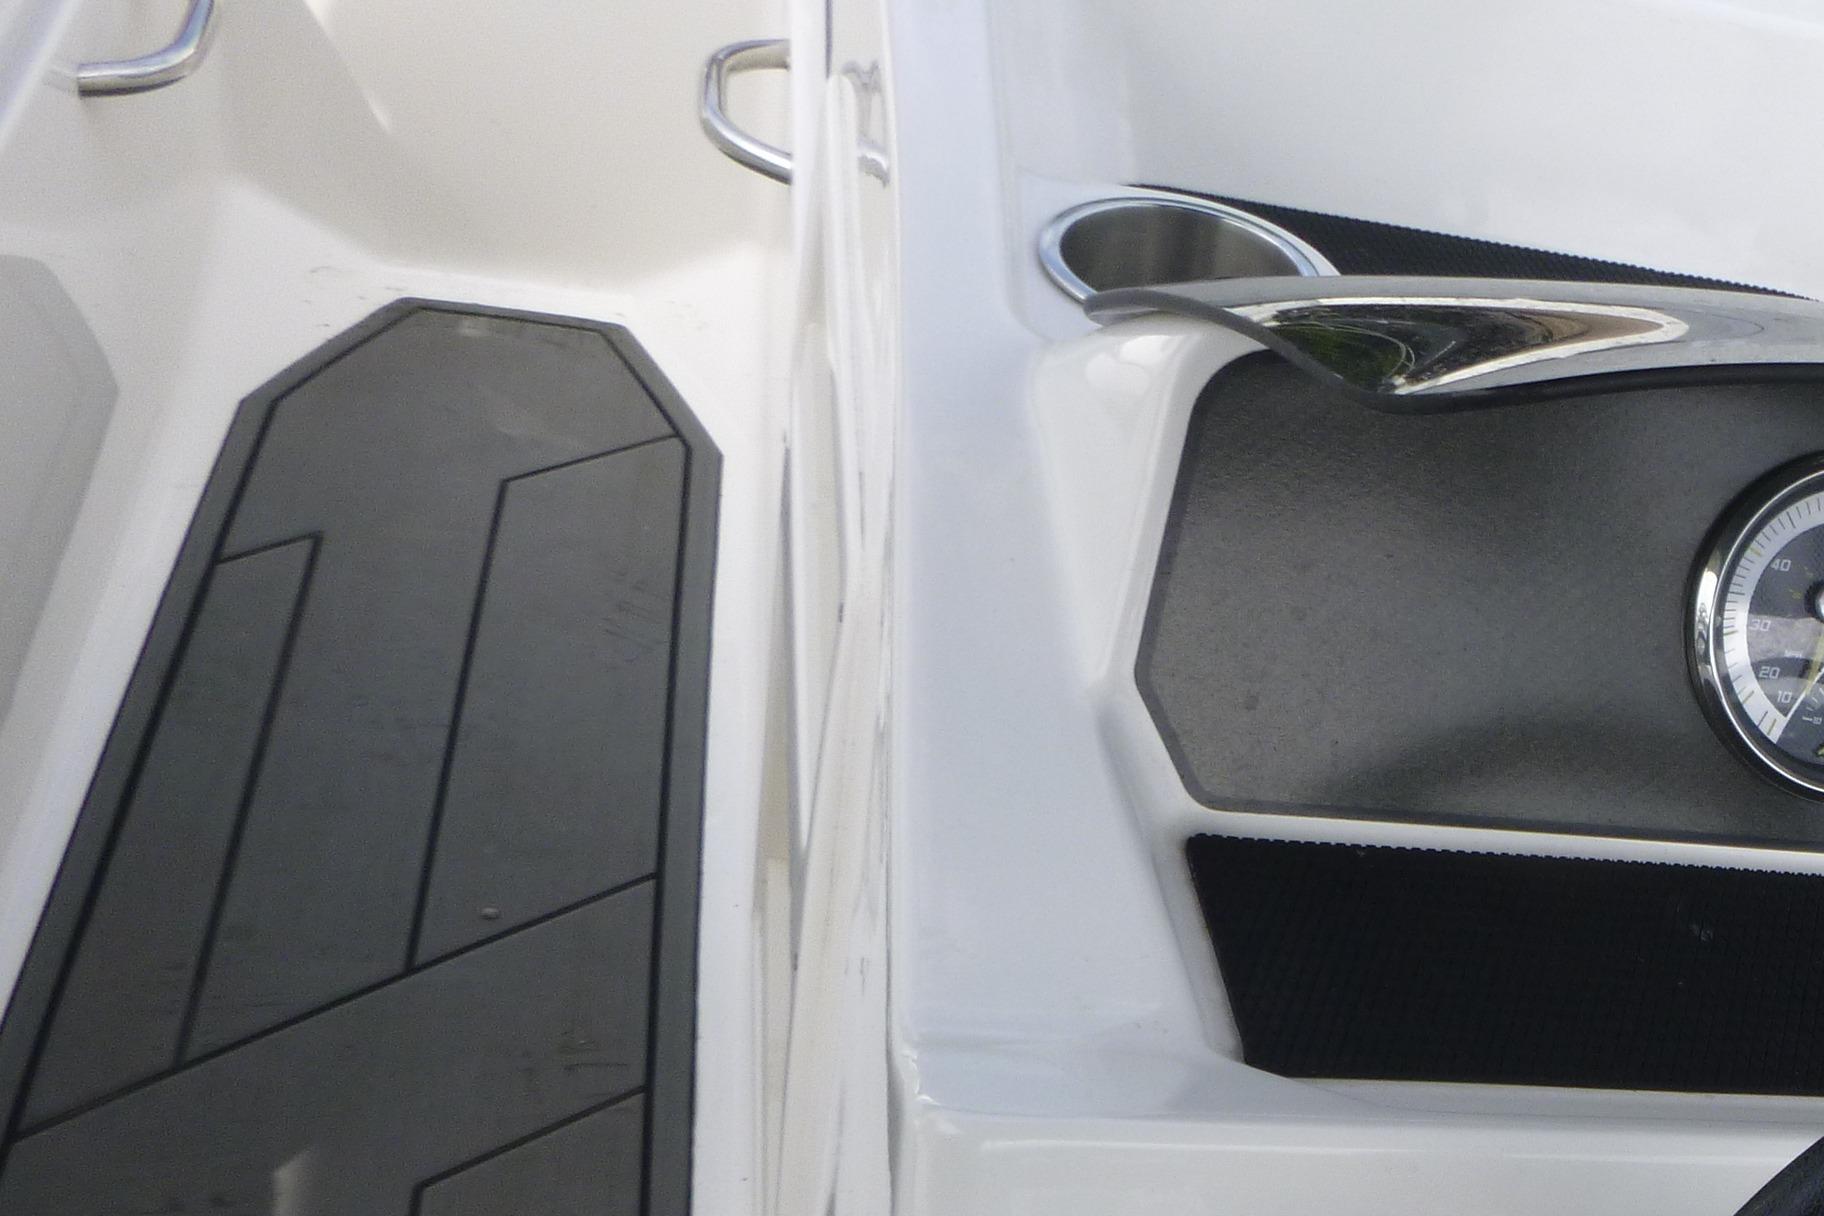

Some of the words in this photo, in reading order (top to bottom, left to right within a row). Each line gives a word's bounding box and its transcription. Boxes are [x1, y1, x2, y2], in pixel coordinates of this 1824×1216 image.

[1770, 559, 1791, 572] 40
[1750, 619, 1771, 632] 30
[1759, 666, 1780, 680] 20
[1777, 690, 1792, 704] 10
